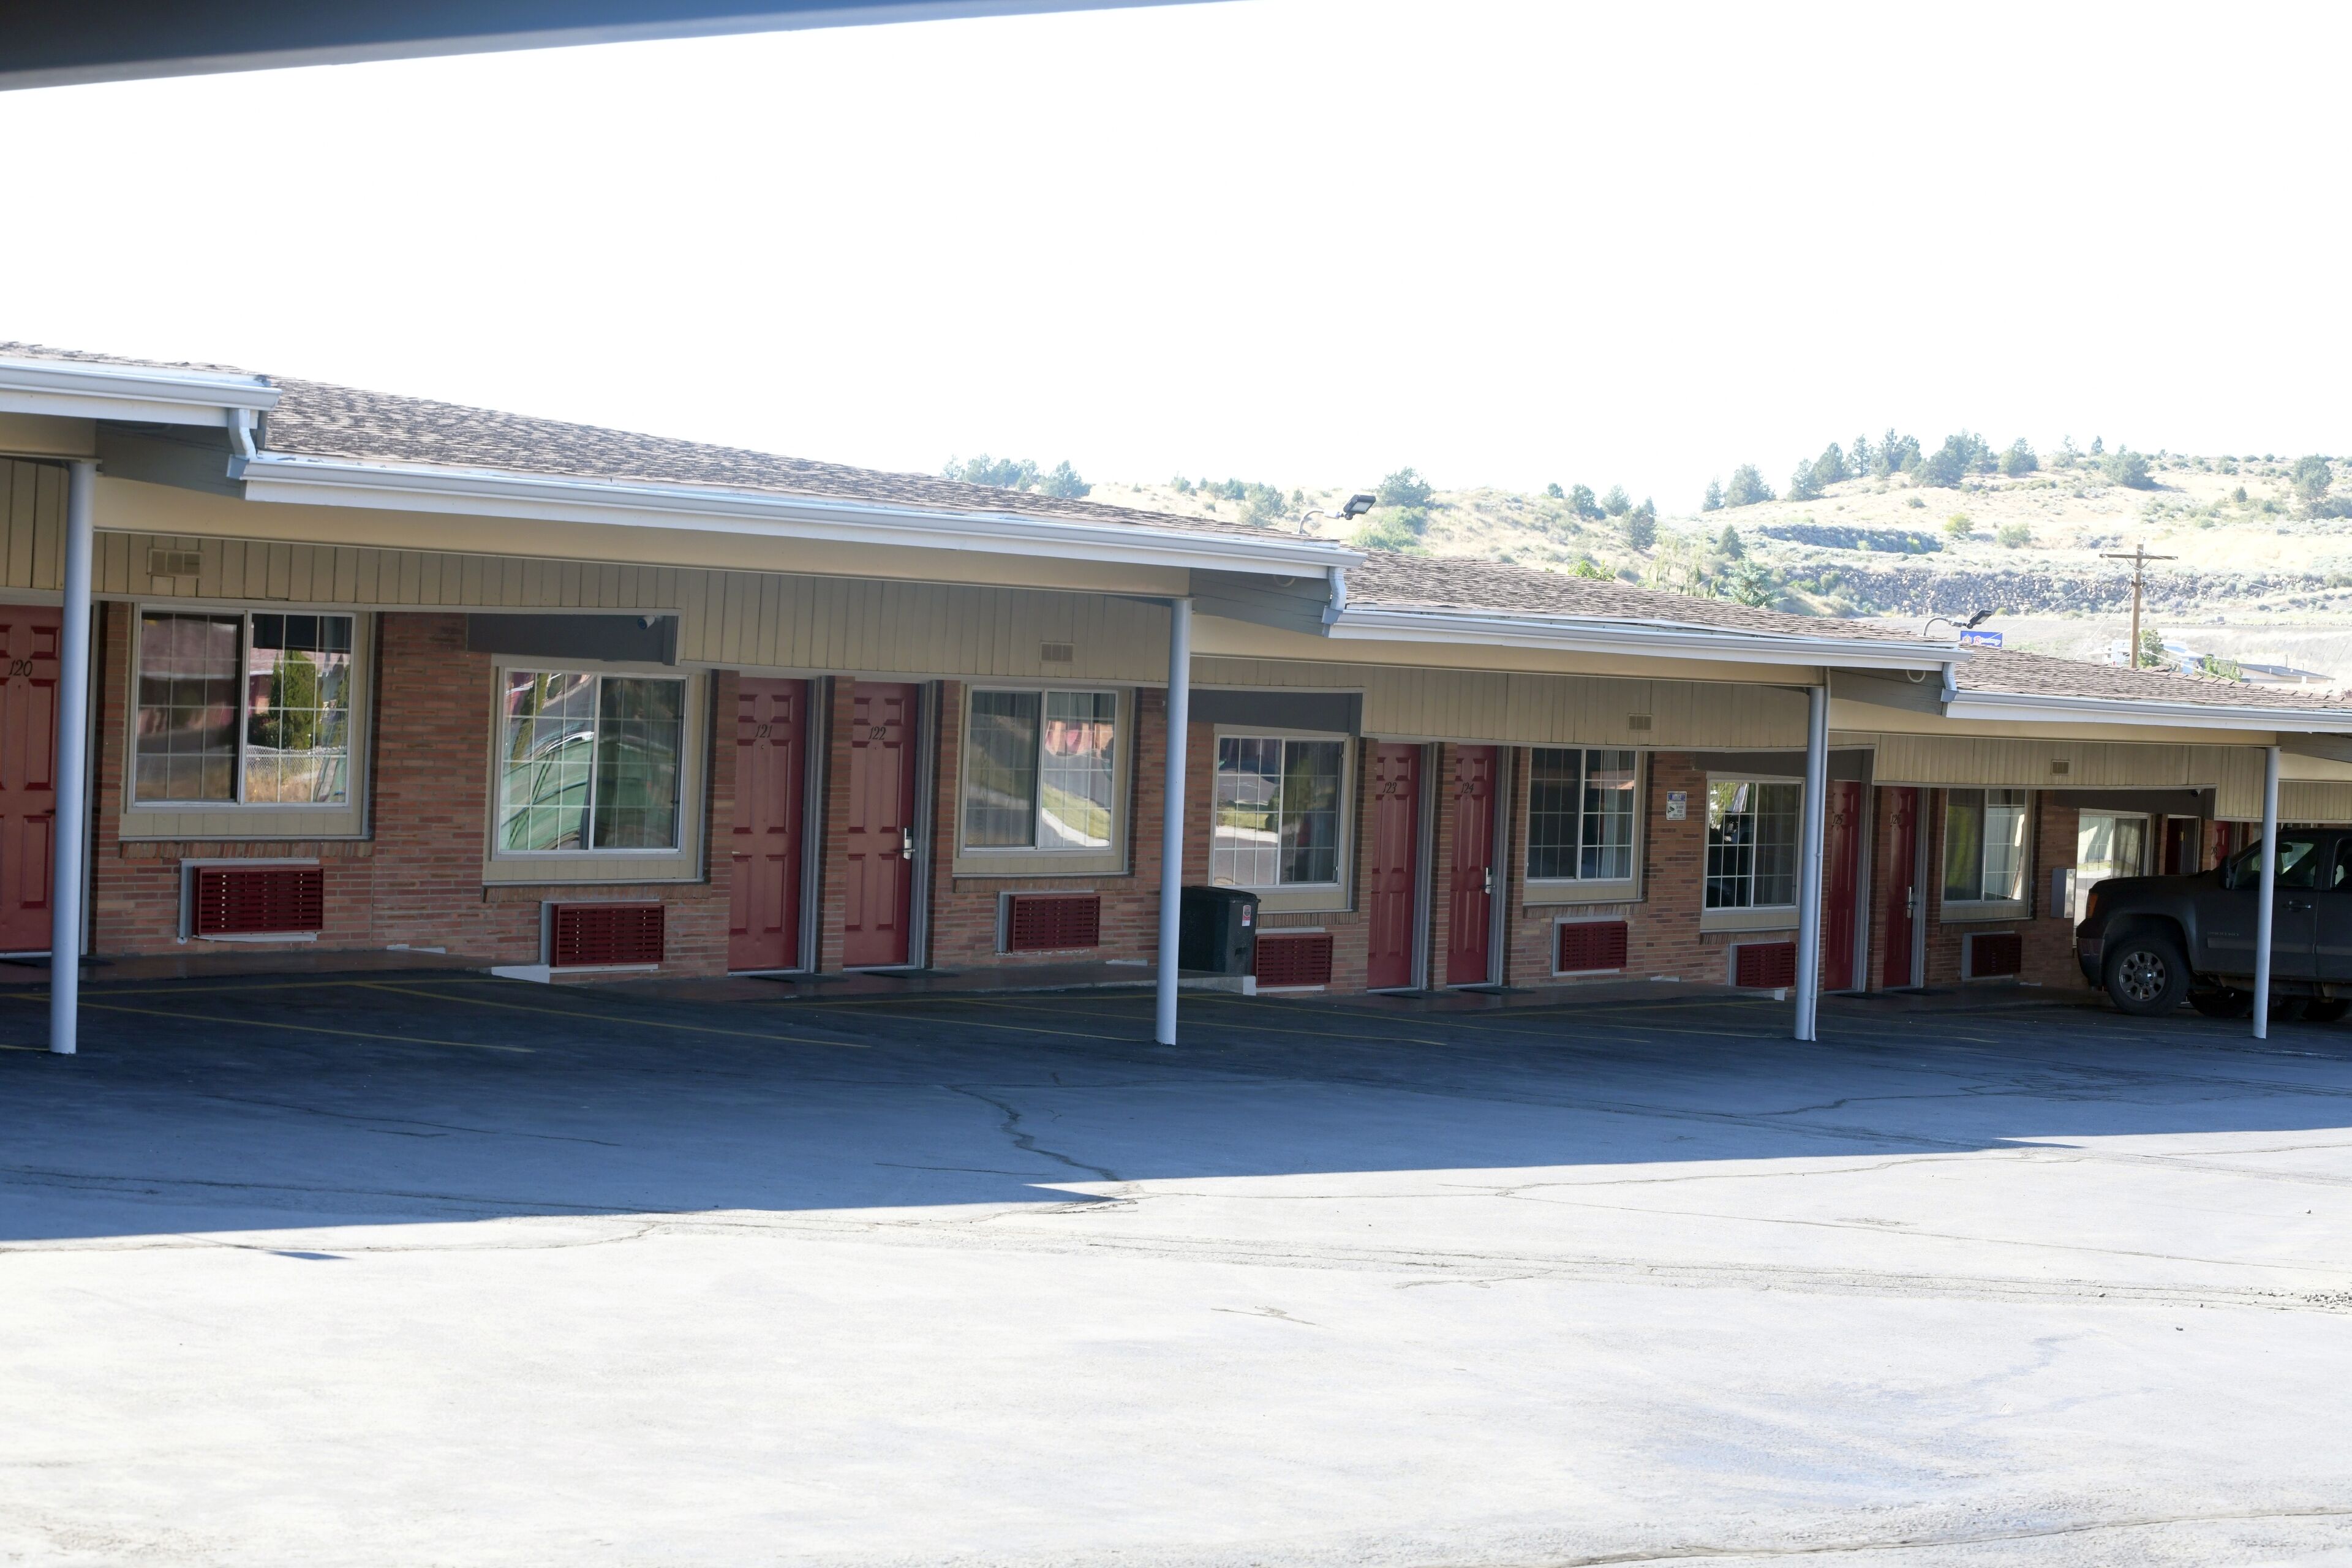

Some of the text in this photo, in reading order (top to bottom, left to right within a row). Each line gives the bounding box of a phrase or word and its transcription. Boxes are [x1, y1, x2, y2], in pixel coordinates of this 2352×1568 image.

[9, 660, 32, 677] 120
[755, 724, 773, 738] 121
[869, 726, 886, 740] 122
[1382, 782, 1397, 794] 123
[1461, 782, 1474, 794] 124
[1833, 814, 1844, 825] 125
[1891, 814, 1901, 824] 126
